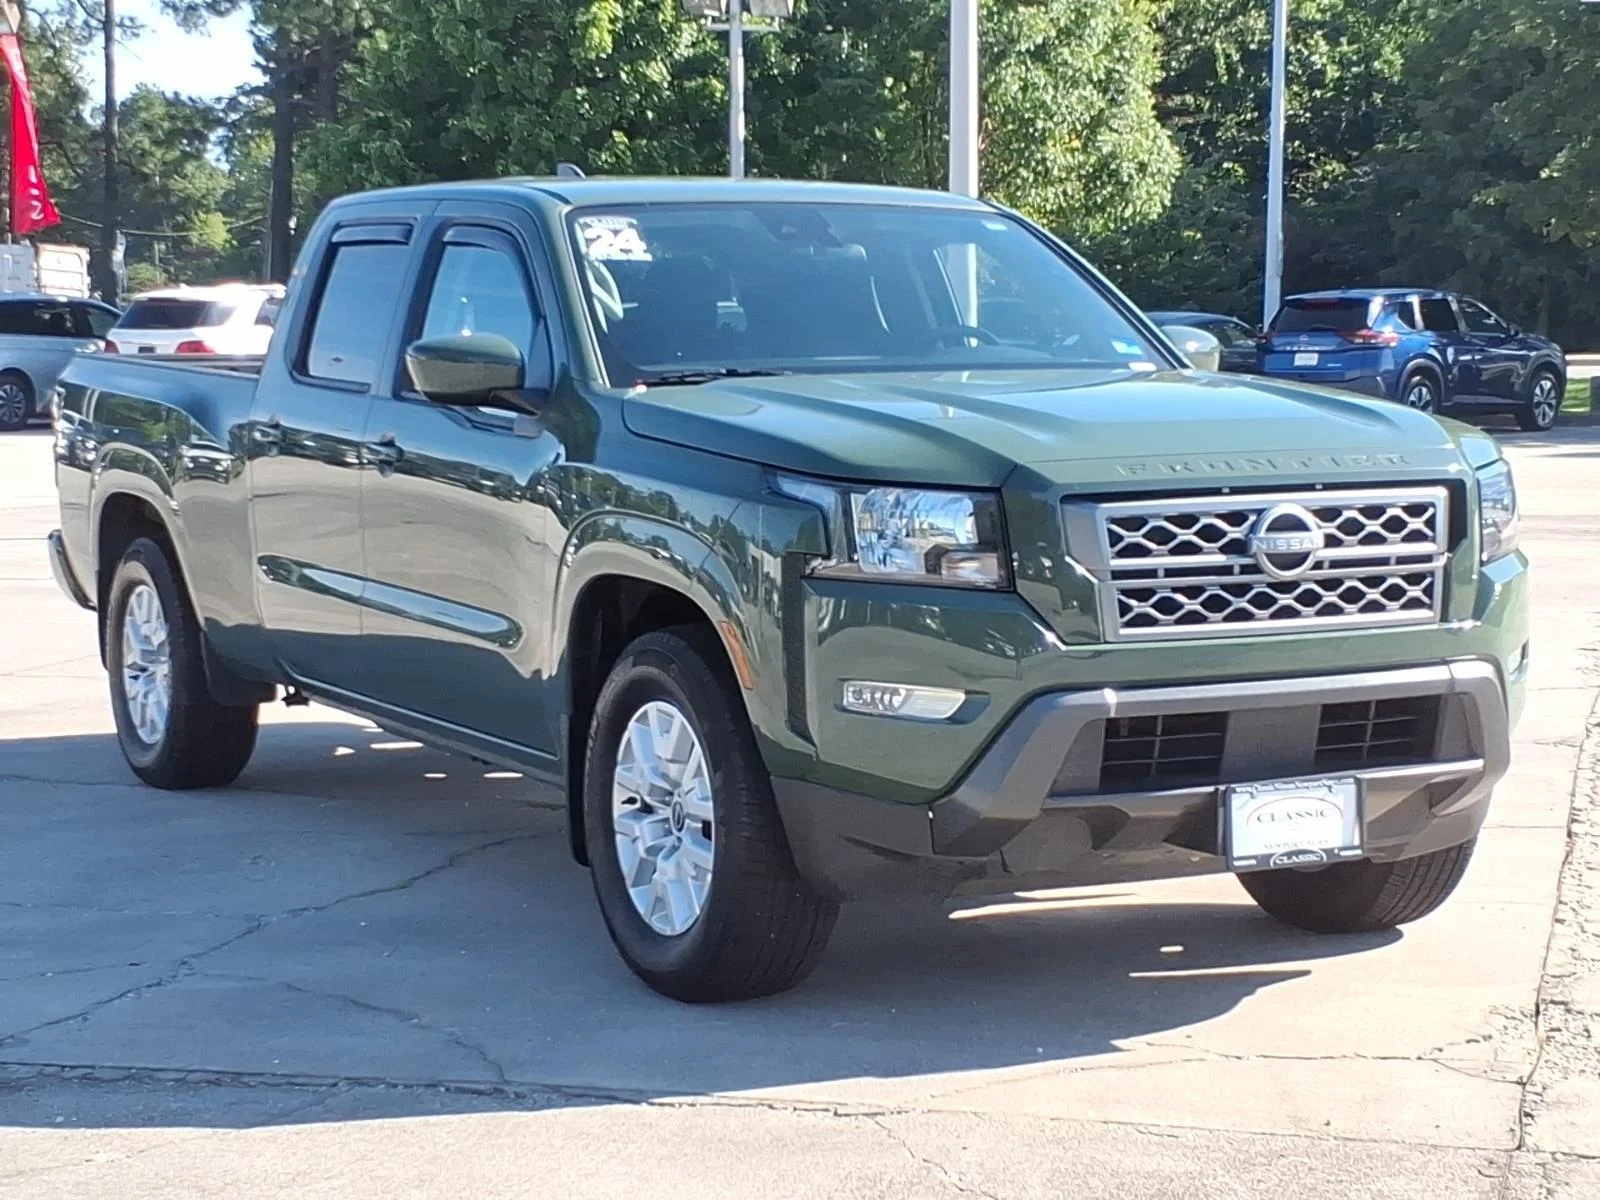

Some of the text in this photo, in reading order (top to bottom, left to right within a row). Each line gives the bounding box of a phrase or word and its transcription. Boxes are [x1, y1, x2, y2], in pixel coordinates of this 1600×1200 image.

[1115, 453, 1412, 477] FRONTIER
[1256, 808, 1332, 823] CLASSIC
[1275, 853, 1321, 865] CLASSIC
